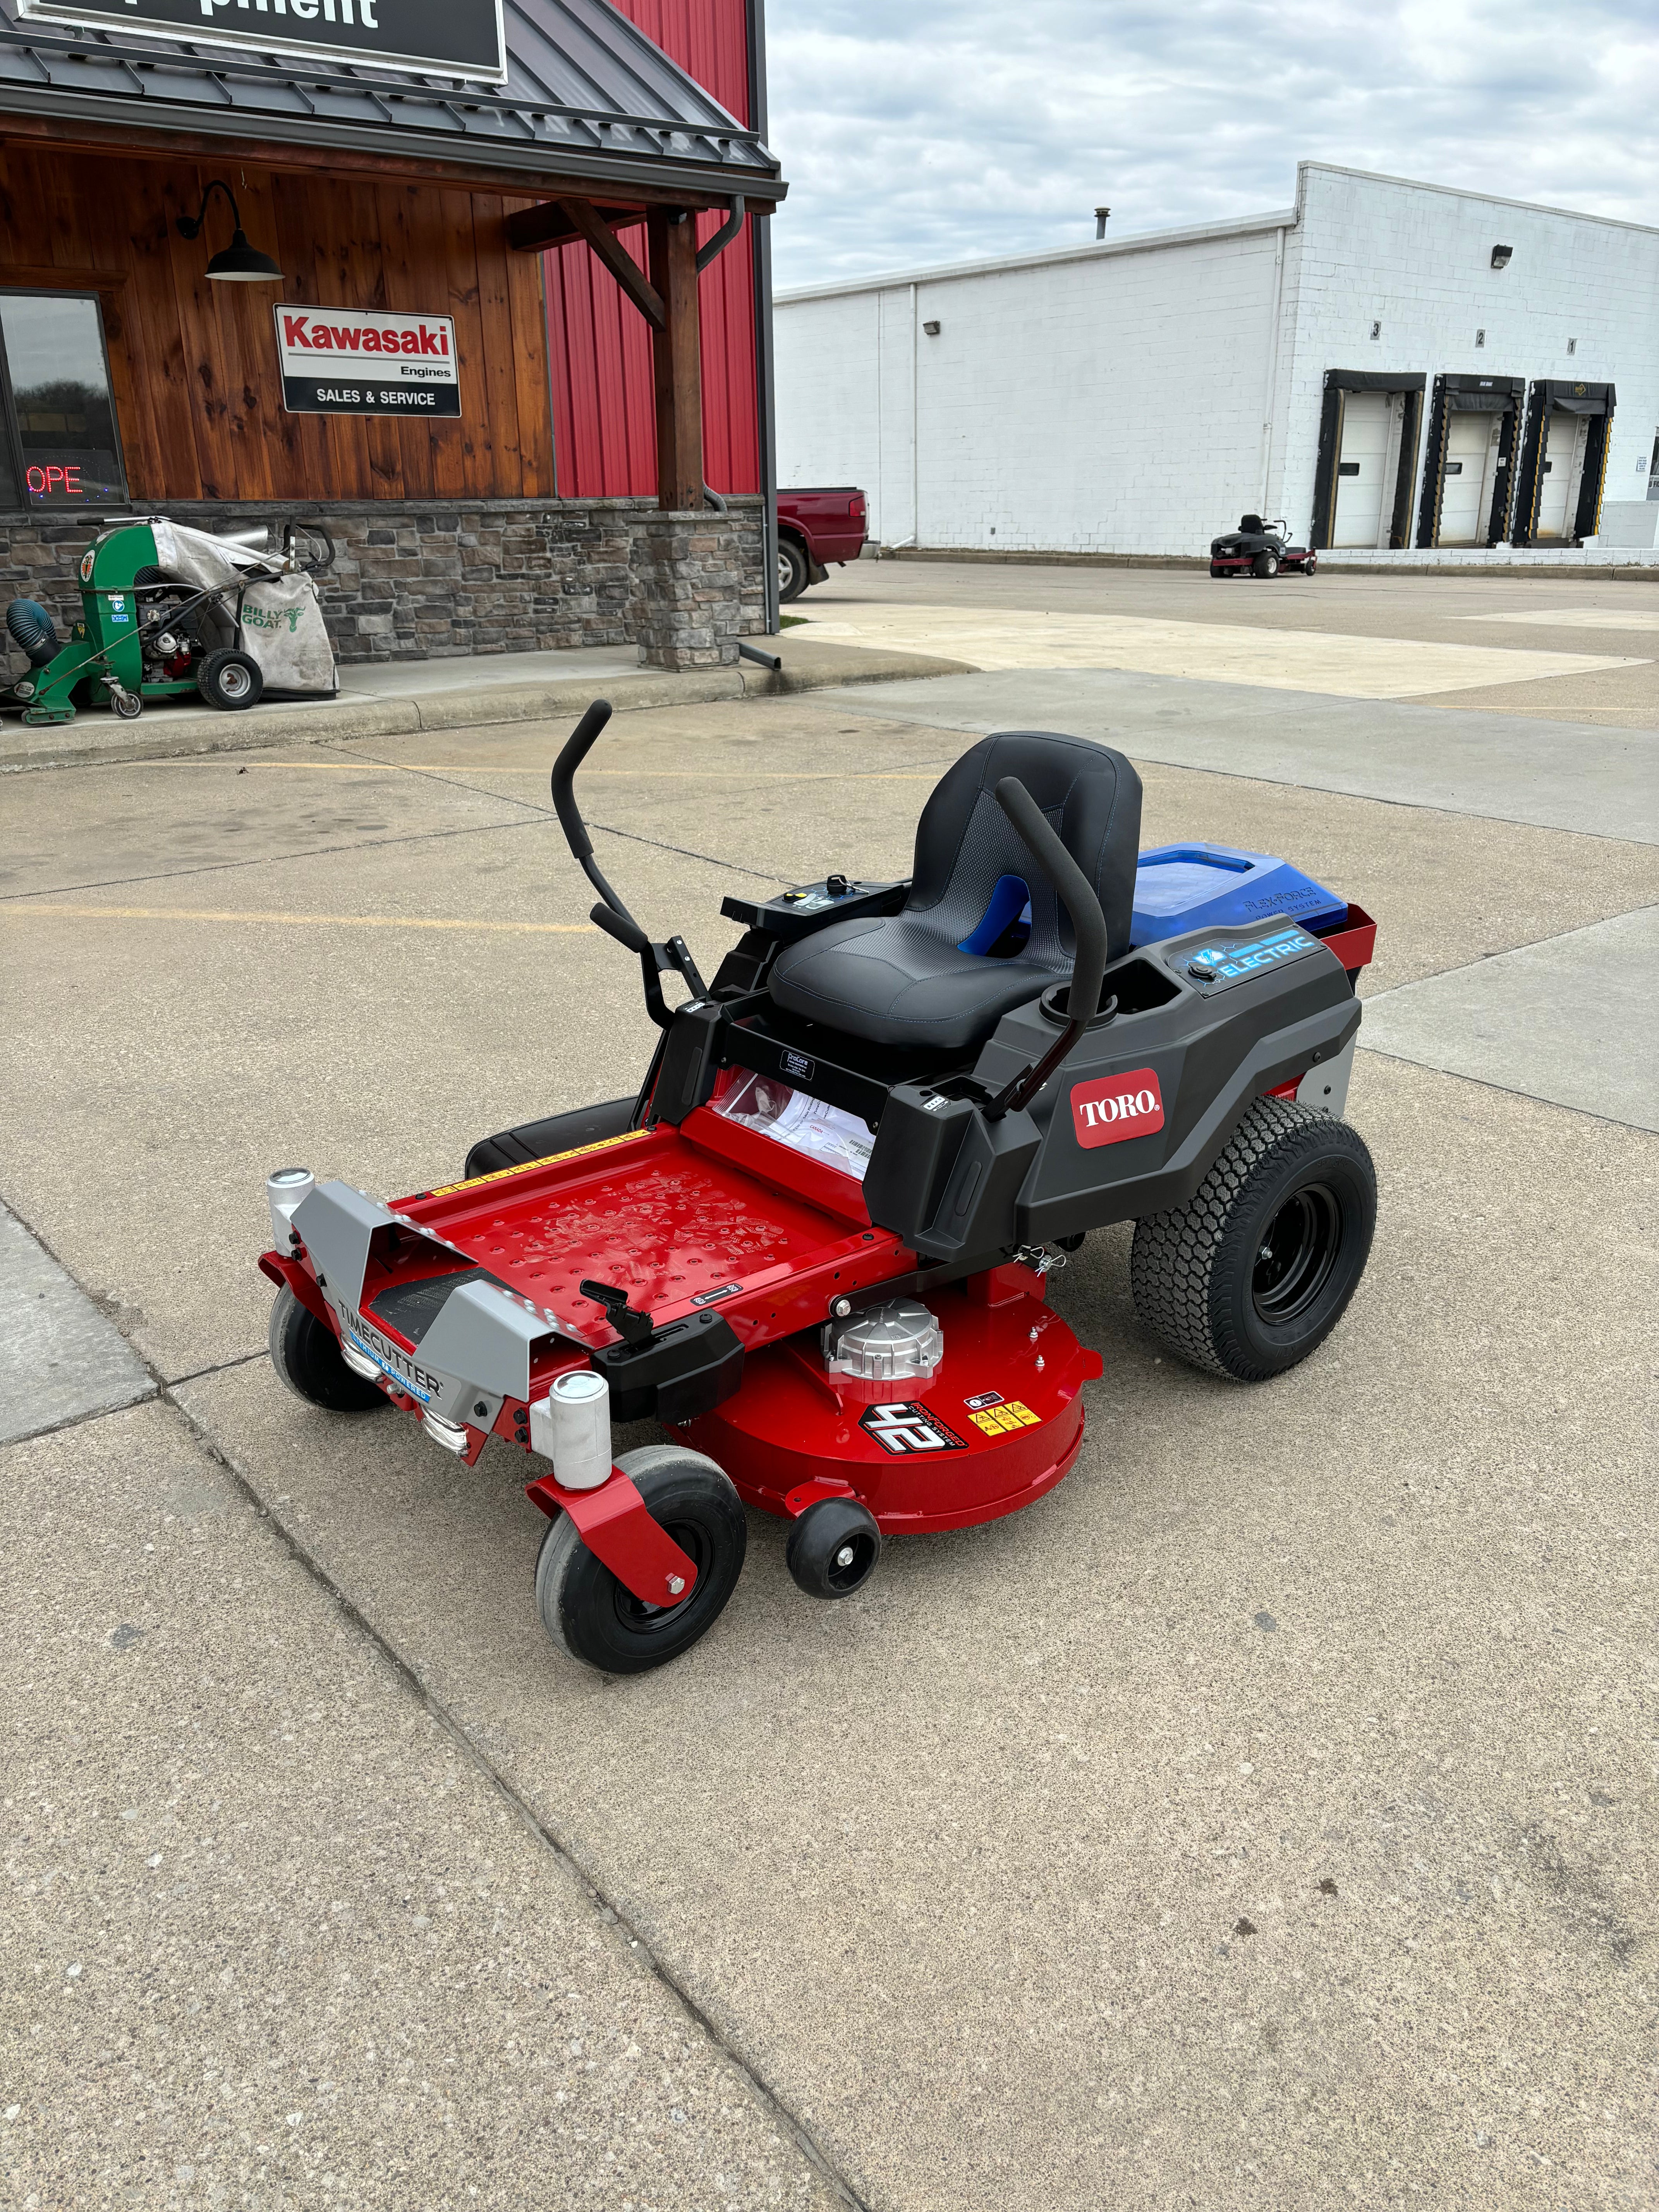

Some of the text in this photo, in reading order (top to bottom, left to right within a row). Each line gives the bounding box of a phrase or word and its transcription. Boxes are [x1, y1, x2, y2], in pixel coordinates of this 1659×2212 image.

[283, 315, 449, 356] Kawasaki
[1373, 323, 1379, 337] 3
[1478, 332, 1484, 344] 2
[1570, 340, 1574, 352] 1
[401, 366, 451, 378] Engines
[317, 388, 435, 405] SALES & SERVICE
[243, 604, 283, 620] BILLY
[1288, 899, 1322, 912] SYSTEM
[1219, 936, 1314, 977] ELECTRIC
[787, 1053, 808, 1065] ProCore
[338, 1300, 442, 1400] TIMECUTTER
[352, 1335, 426, 1400] LITHIUM POWERED
[863, 1403, 946, 1454] 42
[908, 1406, 955, 1446] CUTTING SYSTEM
[910, 1402, 965, 1446] IRONFORGED
